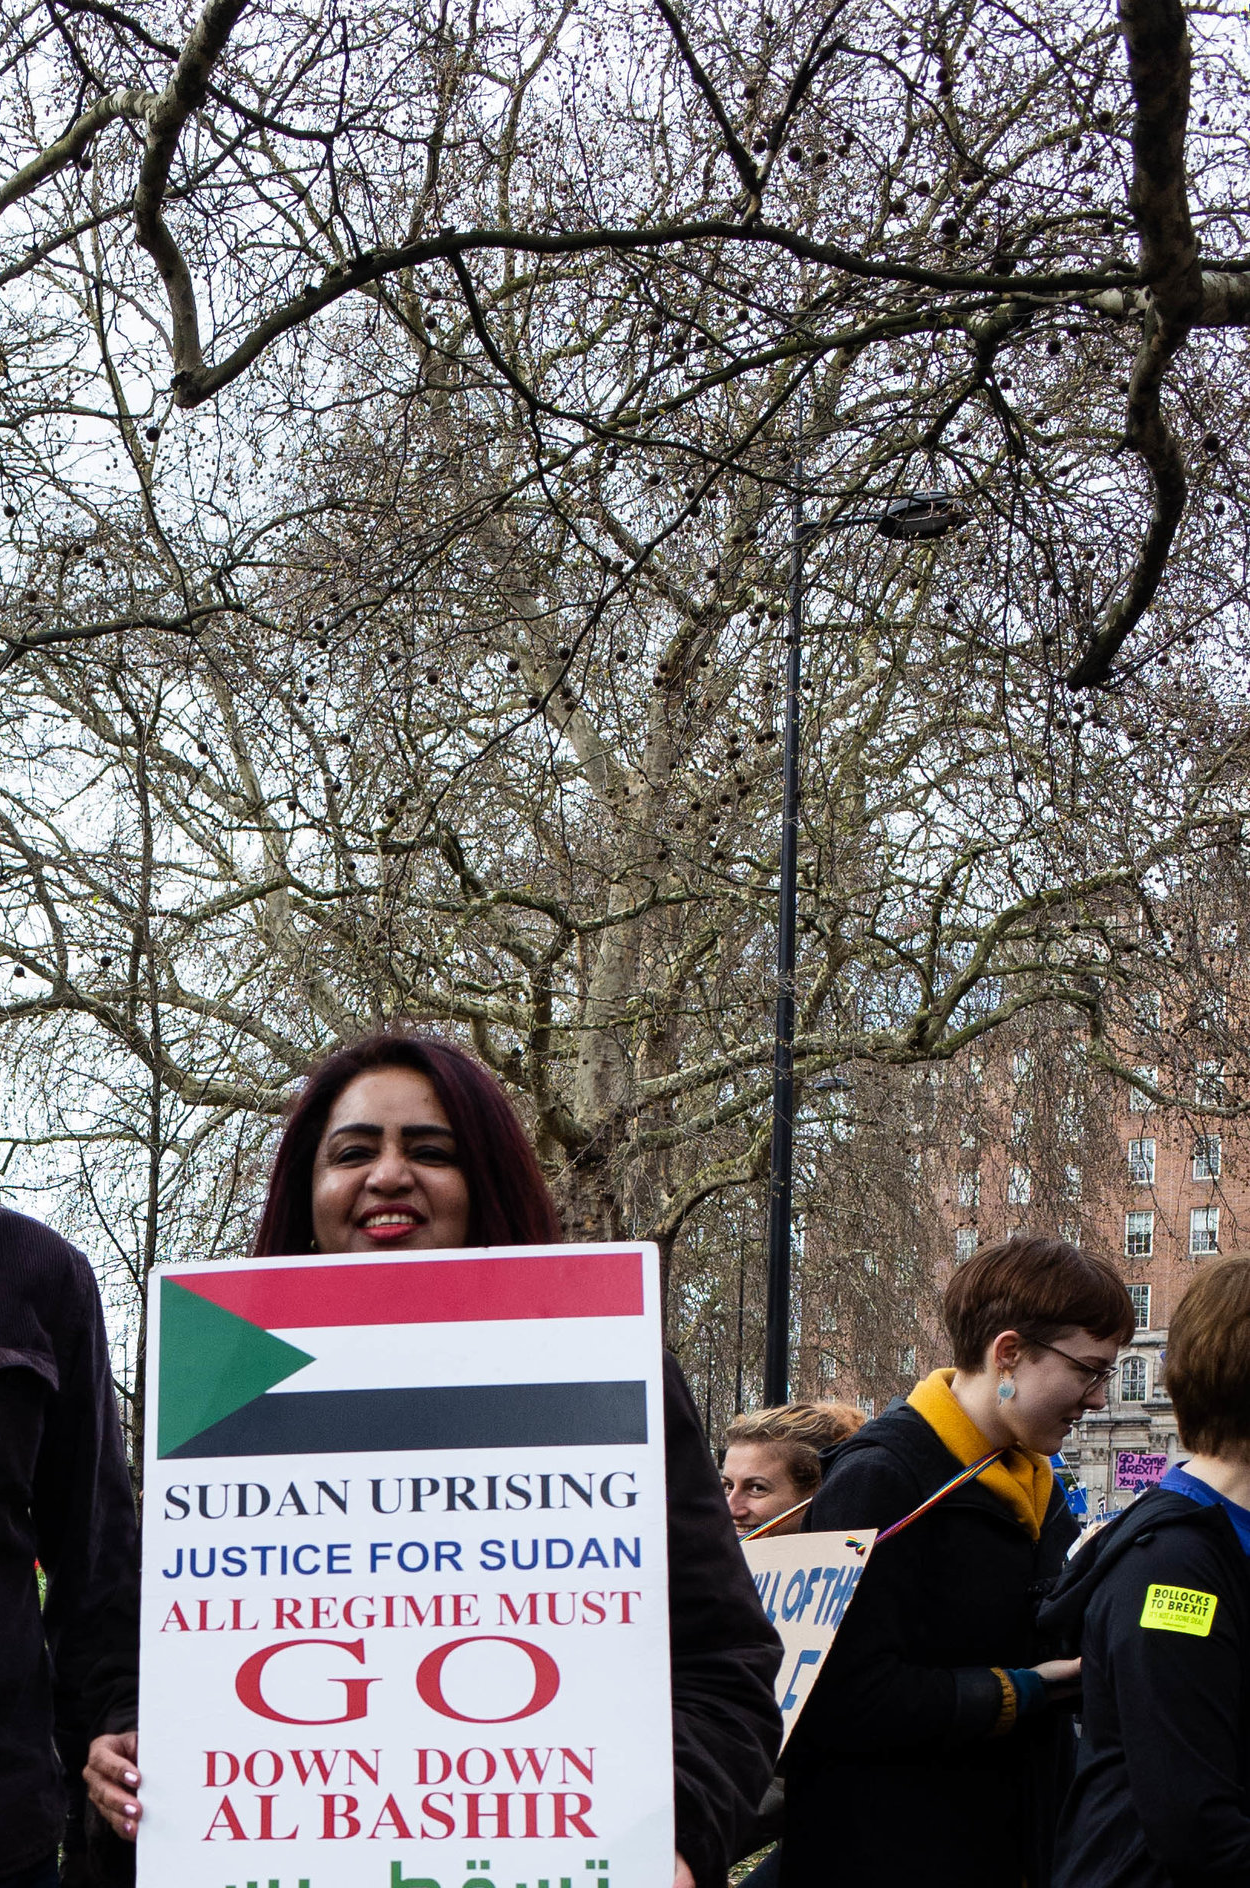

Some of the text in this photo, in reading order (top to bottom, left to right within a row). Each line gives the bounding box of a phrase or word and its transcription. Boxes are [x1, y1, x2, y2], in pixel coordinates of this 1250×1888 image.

[1118, 1464, 1163, 1475] BREXIT
[164, 1472, 639, 1520] SUDAN UPRISING
[162, 1536, 642, 1579] JUSTICE FOR SUDAN
[159, 1591, 642, 1633] ALL REGIME MUST
[782, 1567, 823, 1623] OF
[1151, 1599, 1209, 1617] TO BREXIT
[1153, 1588, 1210, 1607] BOLLOCKS
[234, 1635, 561, 1726] GO
[203, 1747, 598, 1788] DOWN DOWN
[202, 1791, 598, 1842] AL BASHIR
